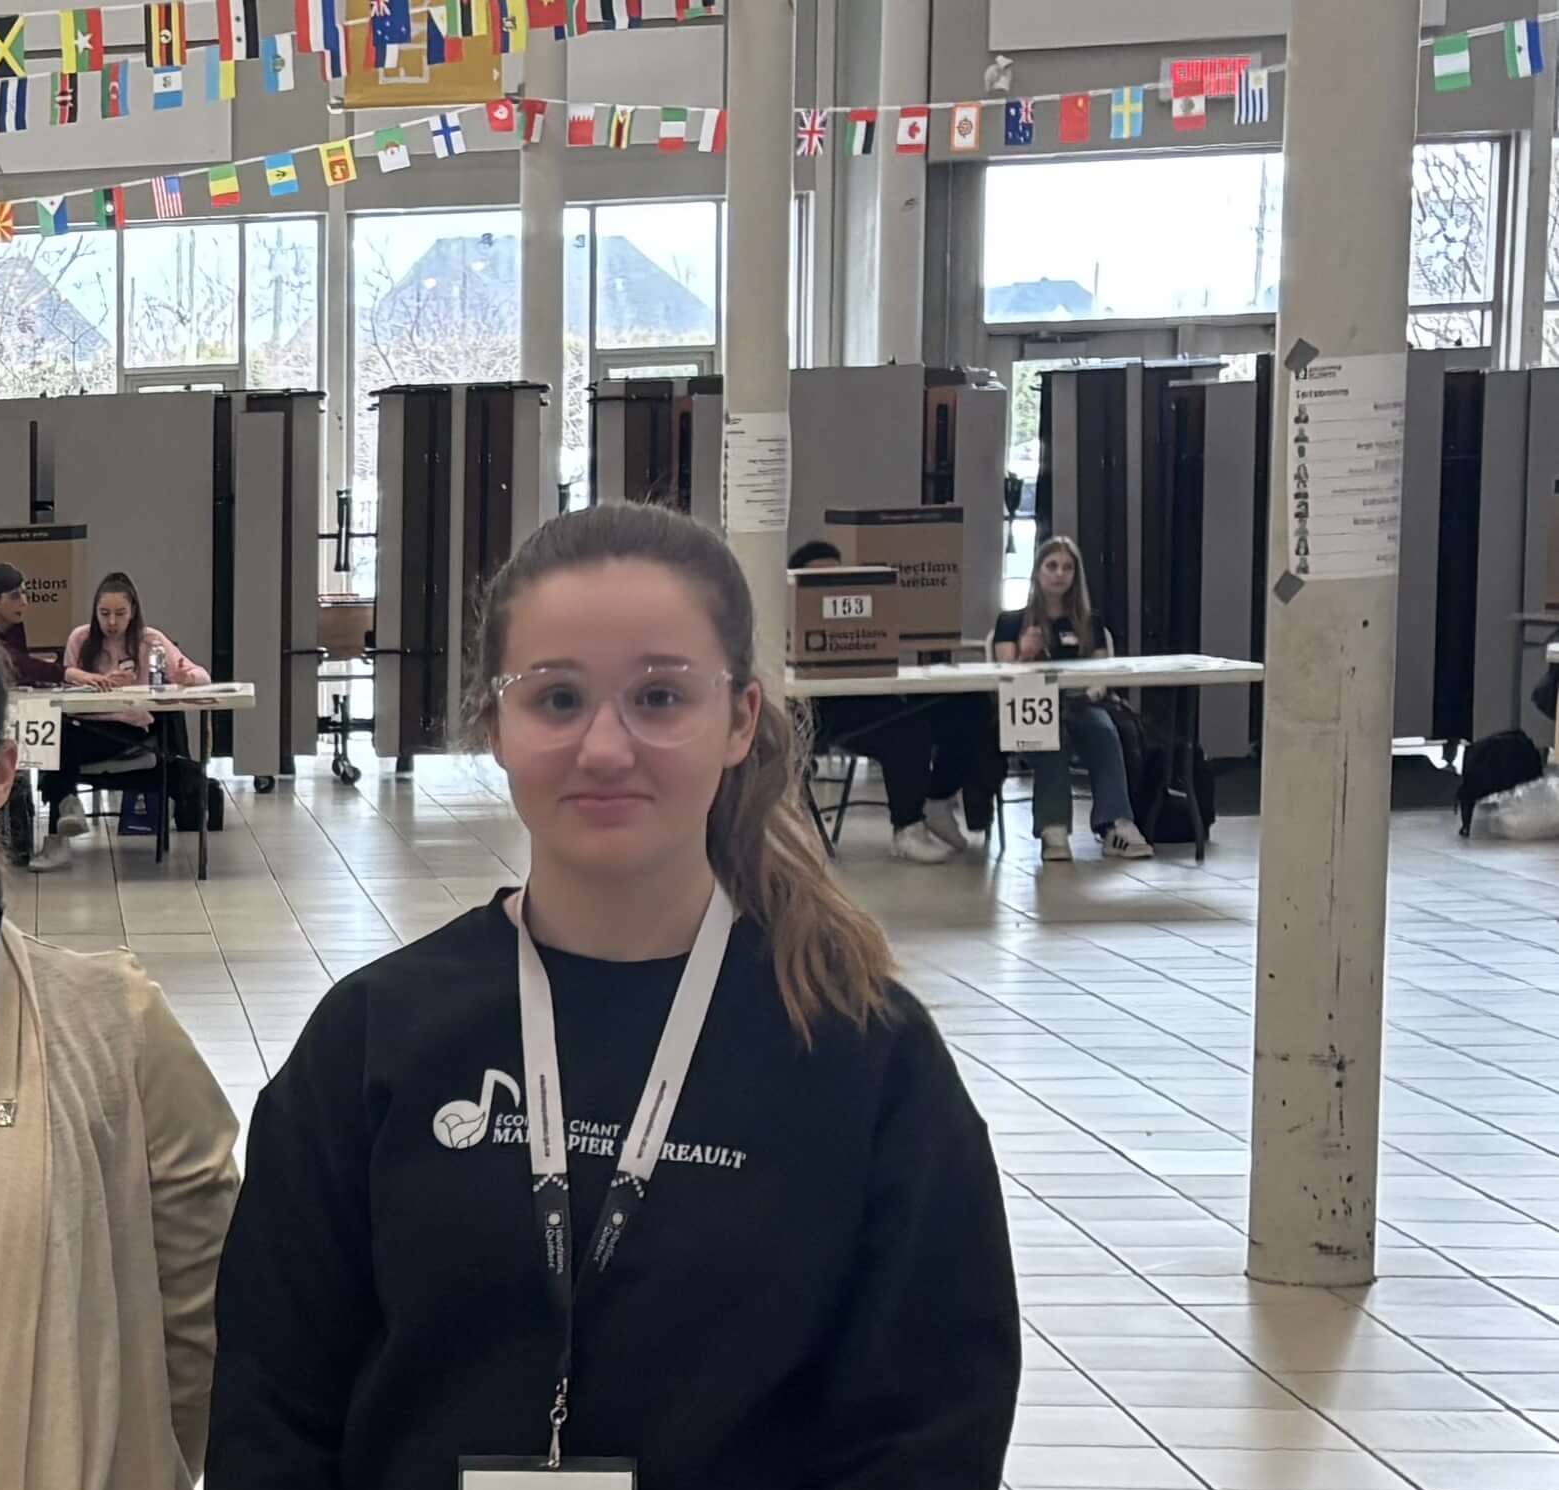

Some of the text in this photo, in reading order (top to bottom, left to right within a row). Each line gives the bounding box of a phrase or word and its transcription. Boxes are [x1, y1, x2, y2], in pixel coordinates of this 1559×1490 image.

[25, 577, 67, 590] ctions
[1006, 697, 1053, 726] 153
[10, 720, 56, 746] 152
[495, 1112, 621, 1138] ÉCO CHANT
[660, 1141, 747, 1169] REAULT
